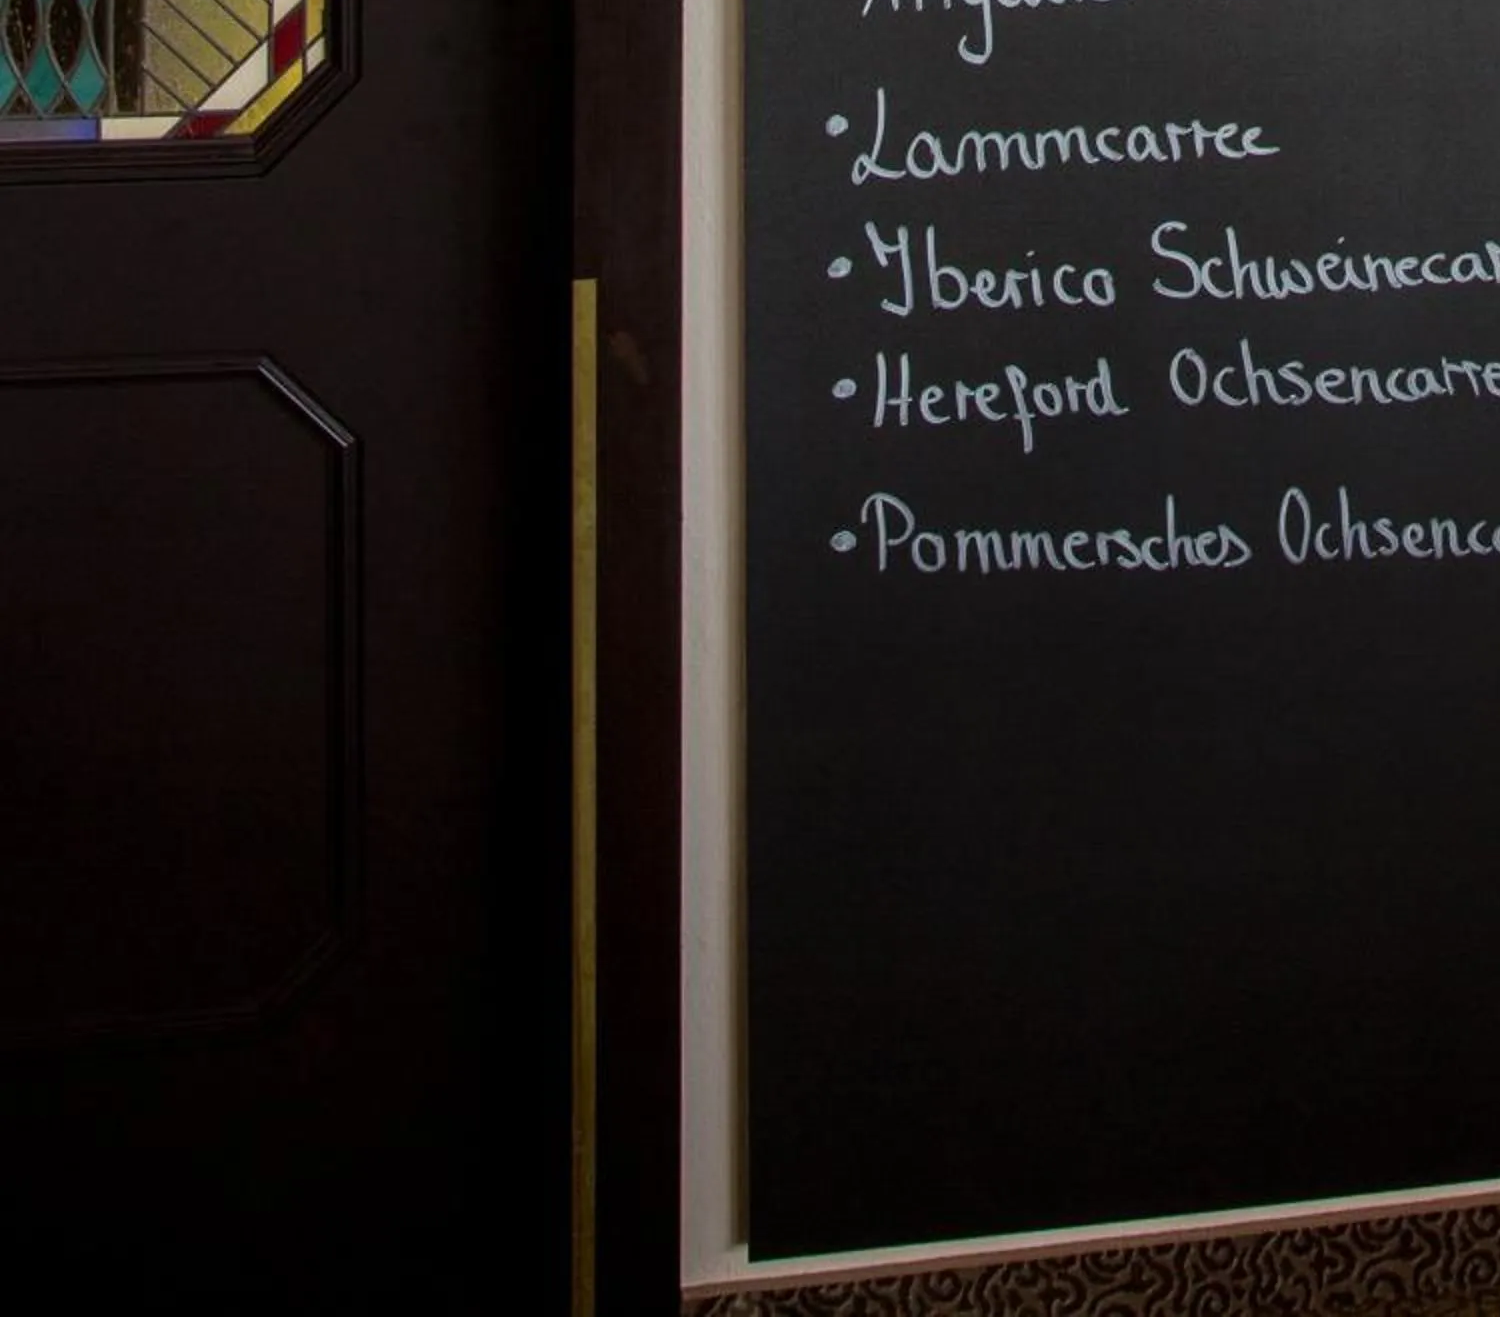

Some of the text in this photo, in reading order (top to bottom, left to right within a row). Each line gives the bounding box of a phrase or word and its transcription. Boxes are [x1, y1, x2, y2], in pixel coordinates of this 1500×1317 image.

[852, 87, 1281, 185] Lammcarree
[872, 351, 1129, 453] Hereford
[860, 491, 1251, 573] Pommersches
